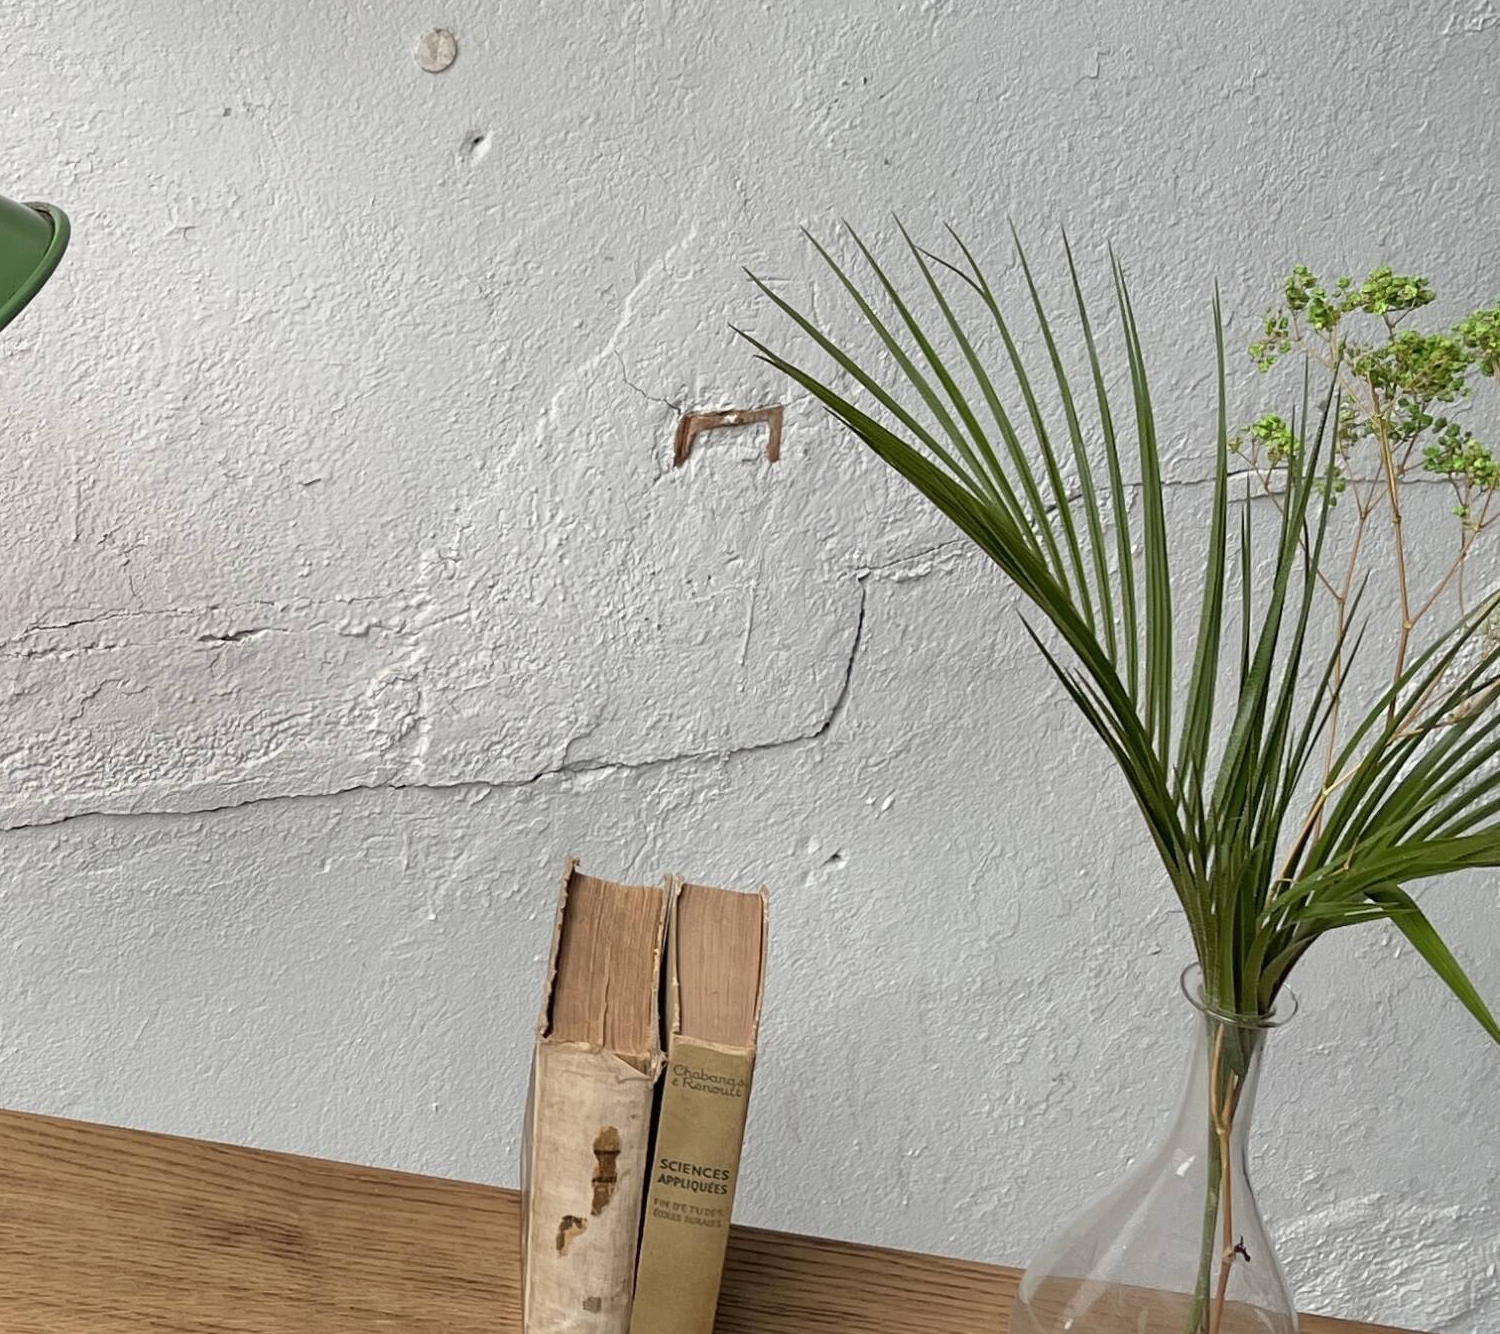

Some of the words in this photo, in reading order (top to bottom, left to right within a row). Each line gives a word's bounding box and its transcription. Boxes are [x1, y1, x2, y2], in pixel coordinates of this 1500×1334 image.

[660, 1158, 730, 1180] SCIENCES
[657, 1173, 728, 1195] APPLIQUÉES
[653, 1197, 669, 1208] FIN
